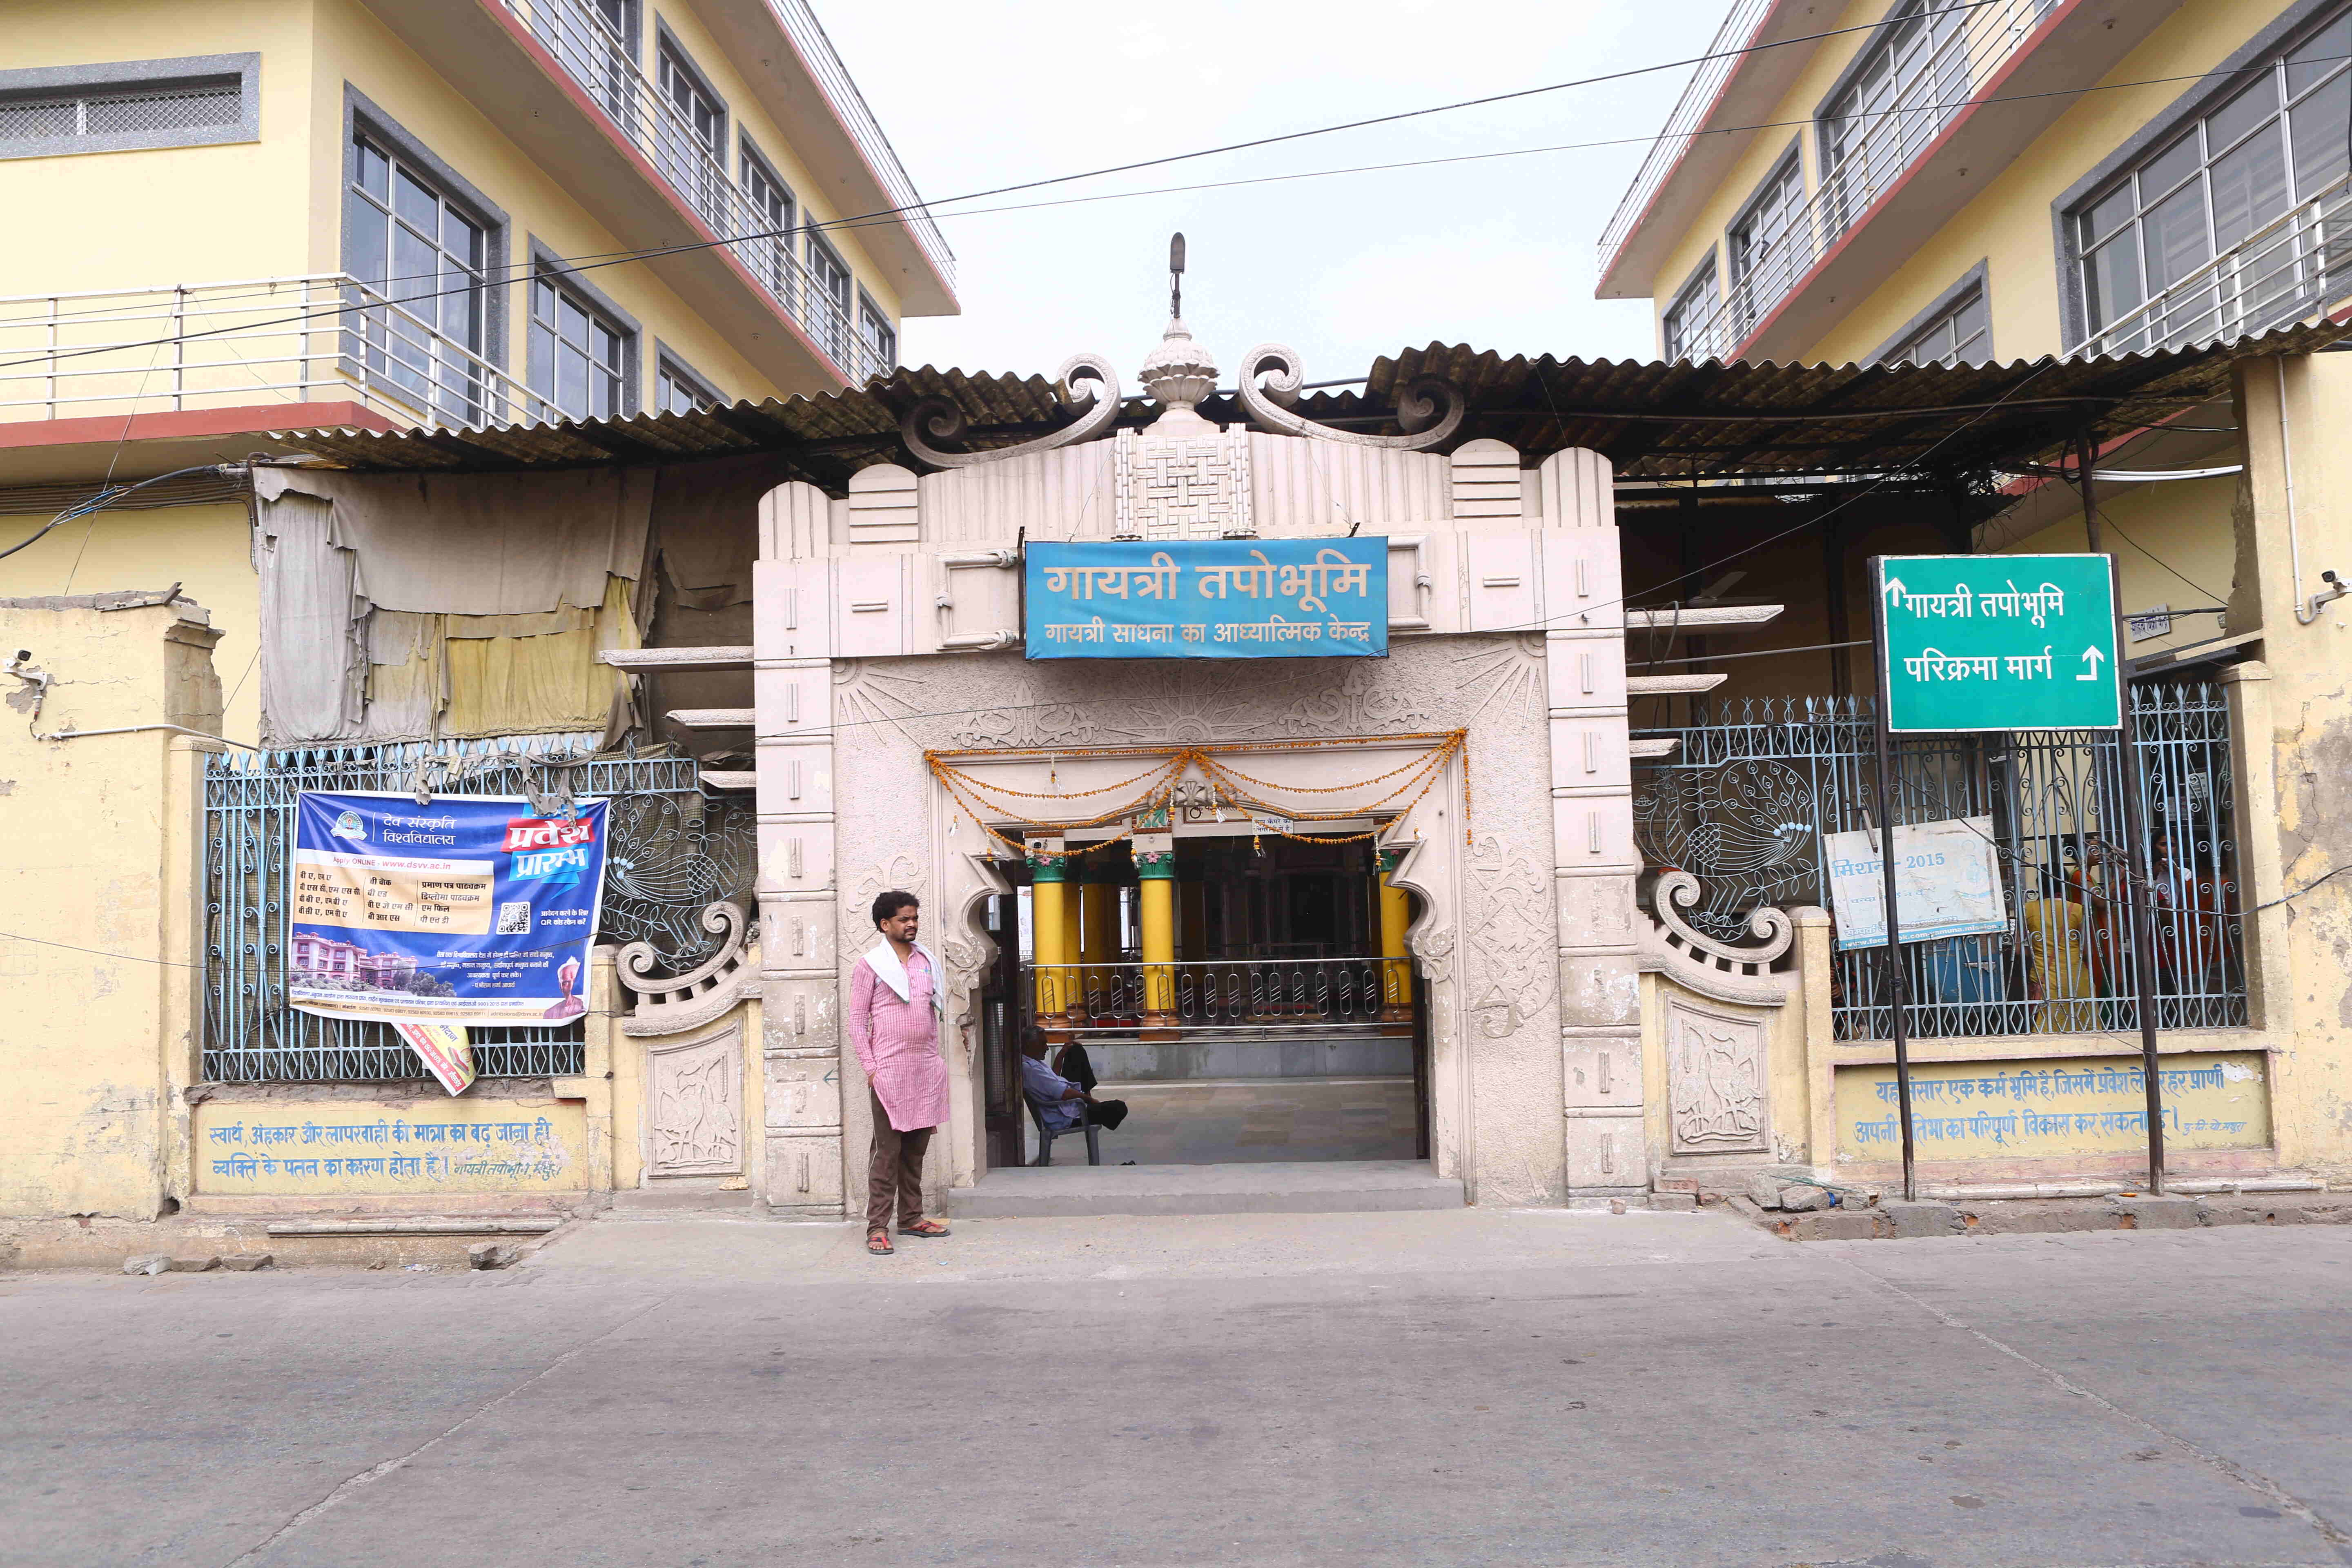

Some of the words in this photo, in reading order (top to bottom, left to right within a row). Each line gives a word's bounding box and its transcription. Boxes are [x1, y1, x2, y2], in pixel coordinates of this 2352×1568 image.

[1044, 552, 1180, 599] गायत्री
[1195, 549, 1371, 612] तपोभूमि
[1903, 583, 1972, 618] गायत्री
[1979, 579, 2064, 628] तपोभूमि
[1045, 616, 1105, 642] गायत्री
[1111, 624, 1174, 642] साधना
[1180, 624, 1206, 642] का
[1214, 614, 1321, 642] आध्यात्मिक
[1327, 613, 1371, 641] केन्द्र
[1903, 647, 1998, 682] परिक्रमा
[2005, 645, 2052, 680] मार्ग
[382, 813, 404, 827] देव
[408, 815, 457, 832] संस्कृति
[382, 829, 456, 845] विश्वविद्यालय
[509, 821, 590, 849] प्रवेश
[333, 857, 350, 865] Apply
[382, 861, 451, 870] www.dsvv.ac.in
[516, 849, 586, 878] प्रारम्भ
[1905, 852, 1944, 869] 2015
[421, 892, 448, 901] डिप्लोमा
[434, 904, 450, 912] फिल
[1875, 1082, 1900, 1108] यह
[1947, 1079, 1976, 1104] एक
[1978, 1072, 2008, 1098] कर्म
[2009, 1070, 2039, 1103] भूमि
[2054, 1068, 2097, 1097] जिसमें
[2097, 1067, 2129, 1095] प्रवेश
[2129, 1066, 2169, 1095] लेर
[2168, 1070, 2189, 1098] हर
[2189, 1064, 2225, 1089] प्राणी
[301, 1121, 326, 1146] और
[325, 1118, 390, 1149] लापरवाही
[391, 1119, 411, 1143] की
[413, 1124, 448, 1143] मात्रा
[450, 1124, 469, 1143] का
[469, 1124, 492, 1148] बढ़
[494, 1123, 532, 1143] जाना
[534, 1117, 552, 1147] ही
[1853, 1114, 1900, 1143] अपनी
[1946, 1118, 1967, 1140] का
[1965, 1110, 2019, 1148] परिपूर्ण
[2021, 1109, 2074, 1138] विकास
[2074, 1113, 2098, 1137] कर
[2099, 1111, 2148, 1137] सकता
[212, 1152, 260, 1182] व्यक्ति
[261, 1153, 283, 1176] के
[282, 1159, 320, 1182] पतन
[323, 1159, 344, 1177] का
[345, 1158, 388, 1179] कारण
[389, 1151, 421, 1181] होता
